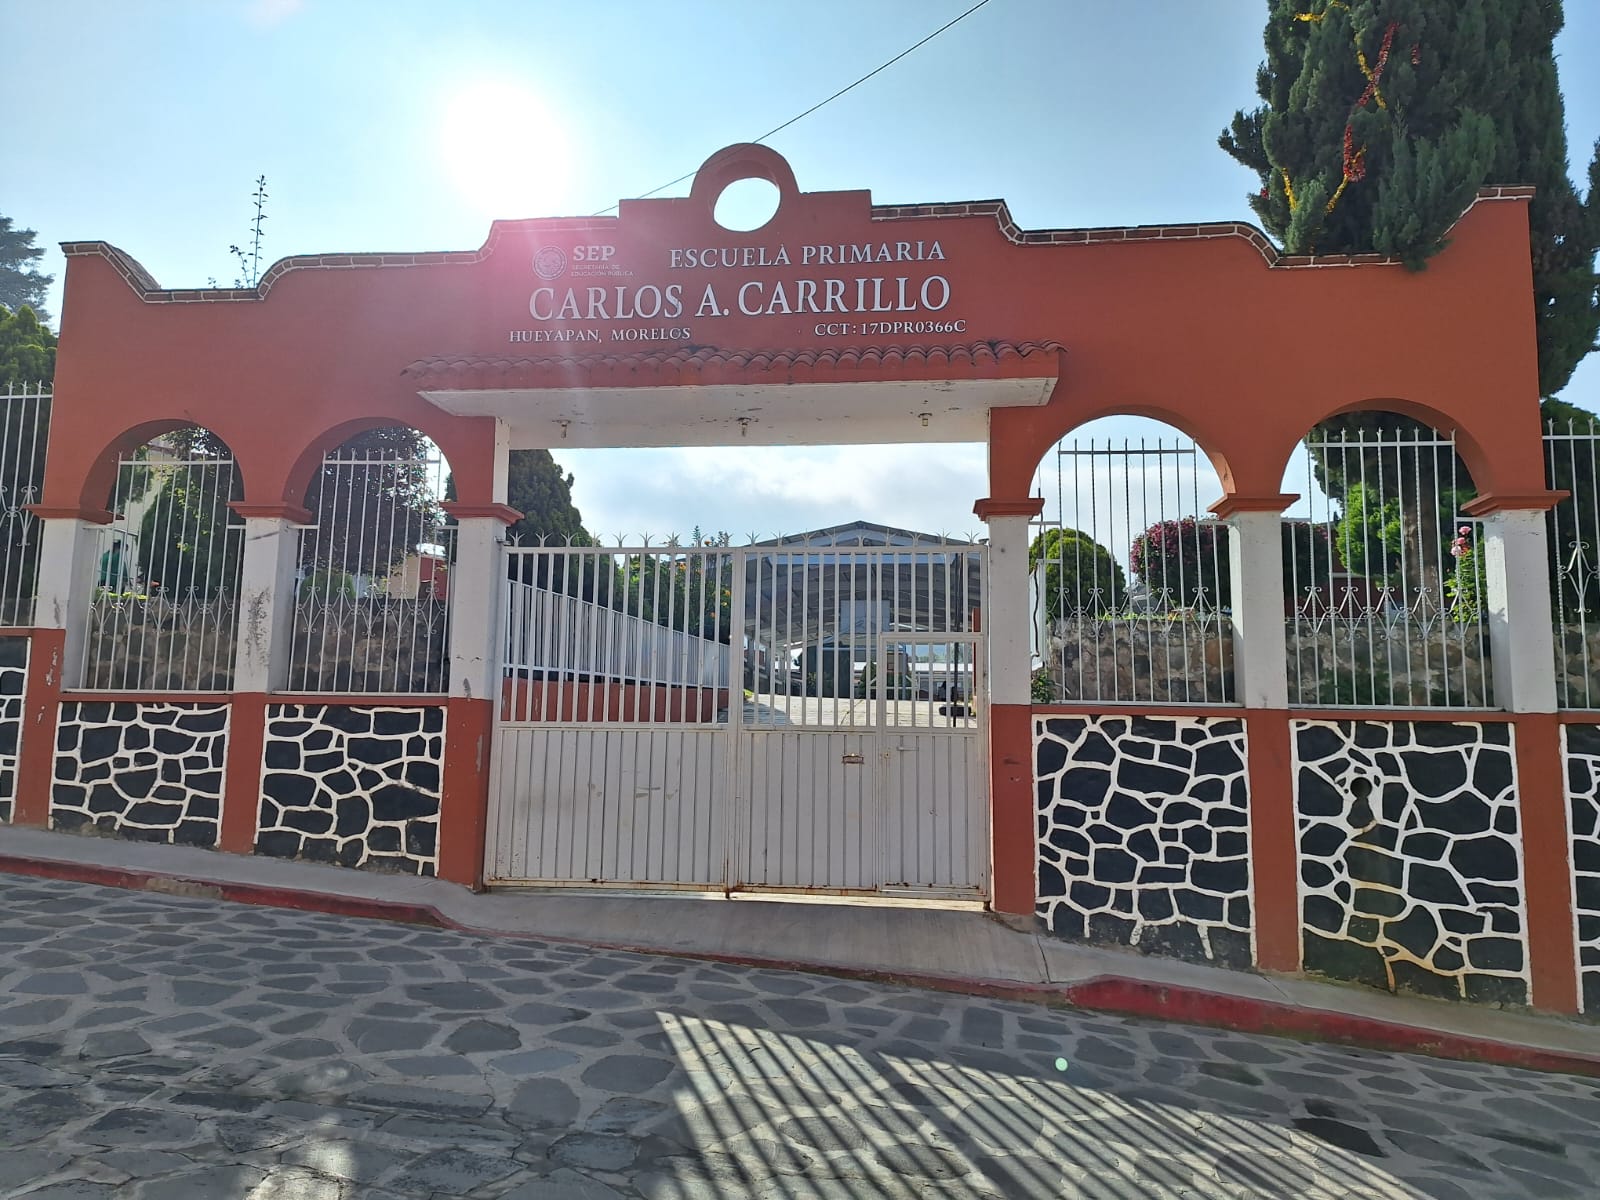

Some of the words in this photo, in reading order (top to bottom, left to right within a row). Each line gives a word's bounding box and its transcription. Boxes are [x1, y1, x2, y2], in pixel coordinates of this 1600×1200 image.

[573, 245, 616, 261] SEP
[670, 245, 792, 268] ESCUELA
[801, 240, 946, 265] PRIMARIA
[529, 284, 683, 320] CARLOS
[694, 283, 730, 317] A.
[738, 275, 951, 316] CARRILLO
[509, 329, 602, 343] HUEYAPAN,
[611, 327, 691, 341] MORELOS
